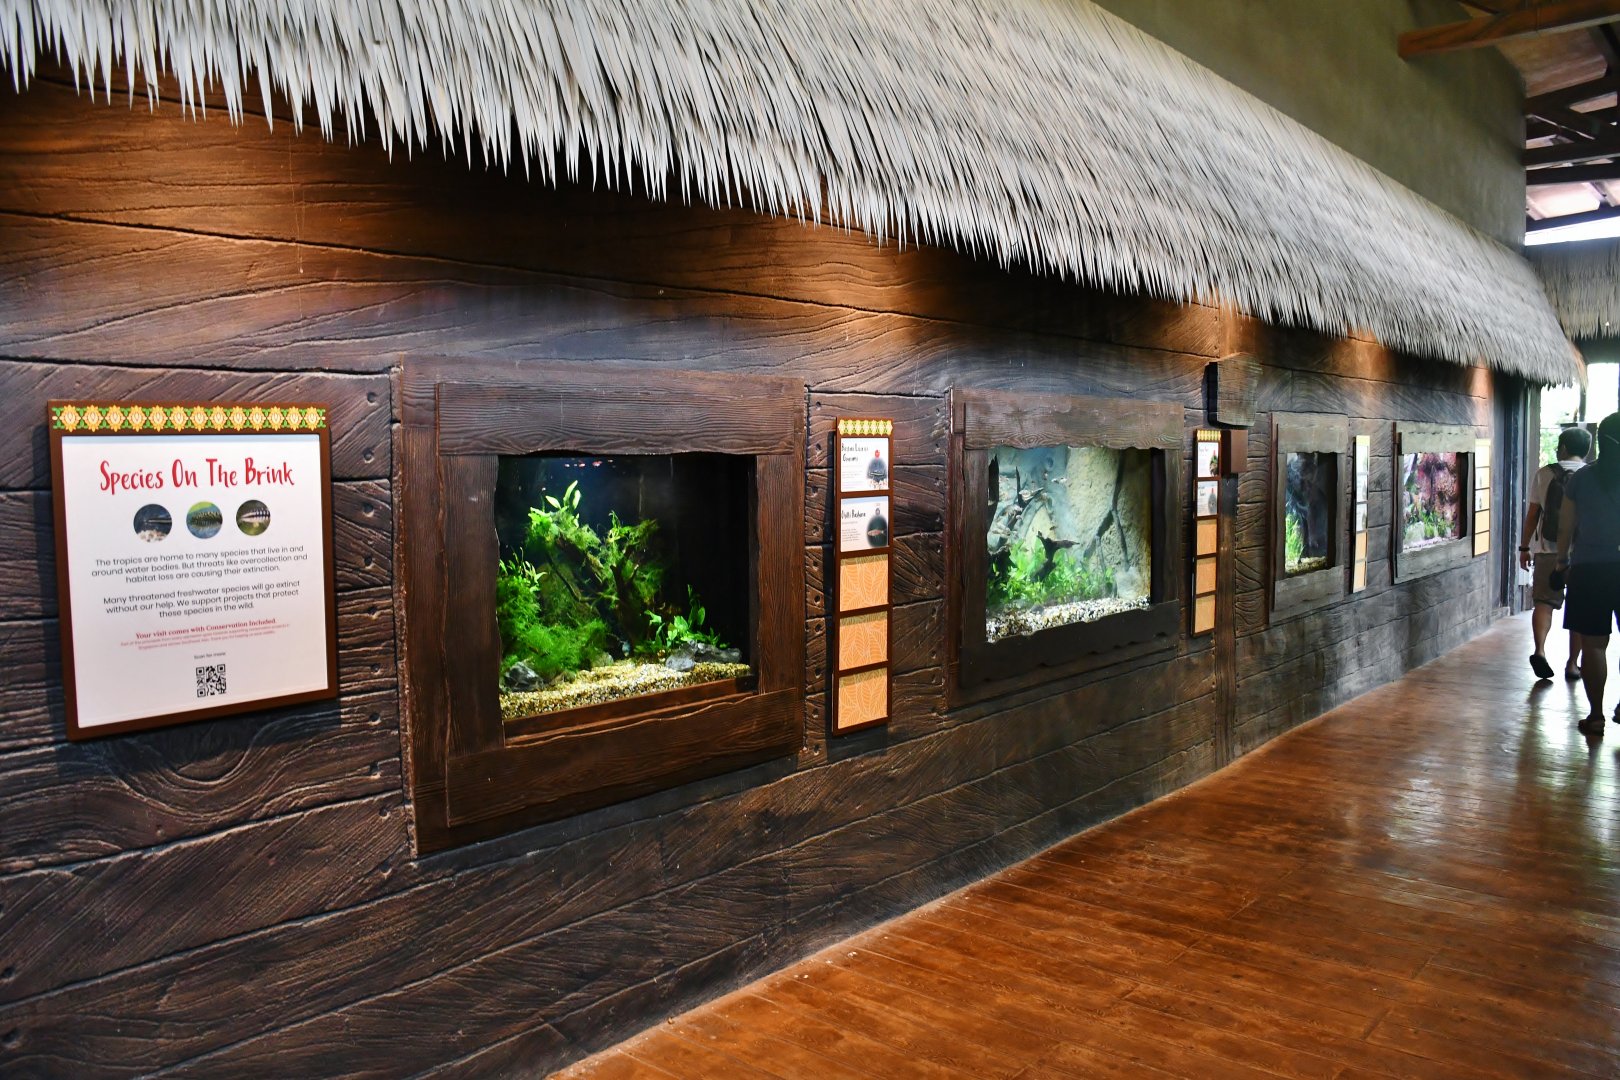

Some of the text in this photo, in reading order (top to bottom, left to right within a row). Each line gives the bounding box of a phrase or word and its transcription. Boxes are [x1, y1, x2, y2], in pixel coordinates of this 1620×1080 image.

[100, 457, 295, 495] Species On The Brink
[92, 568, 123, 577] around
[196, 560, 224, 568] threats
[240, 555, 292, 564] overcollection
[113, 557, 142, 566] tropics
[220, 549, 250, 558] species
[126, 574, 156, 583] habitat
[191, 568, 222, 578] causing
[224, 566, 241, 575] their
[103, 596, 126, 605] Many
[129, 591, 176, 602] threatened
[177, 587, 219, 598] freshwater
[222, 584, 250, 594] species
[265, 582, 274, 591] go
[276, 580, 300, 588] extinct
[106, 605, 138, 614] without
[192, 596, 221, 606] support
[224, 592, 254, 603] projects
[272, 589, 299, 598] protect
[159, 609, 182, 618] these
[184, 606, 214, 616] species
[224, 603, 236, 611] the
[152, 630, 167, 638] visit
[206, 622, 248, 632] Conservation
